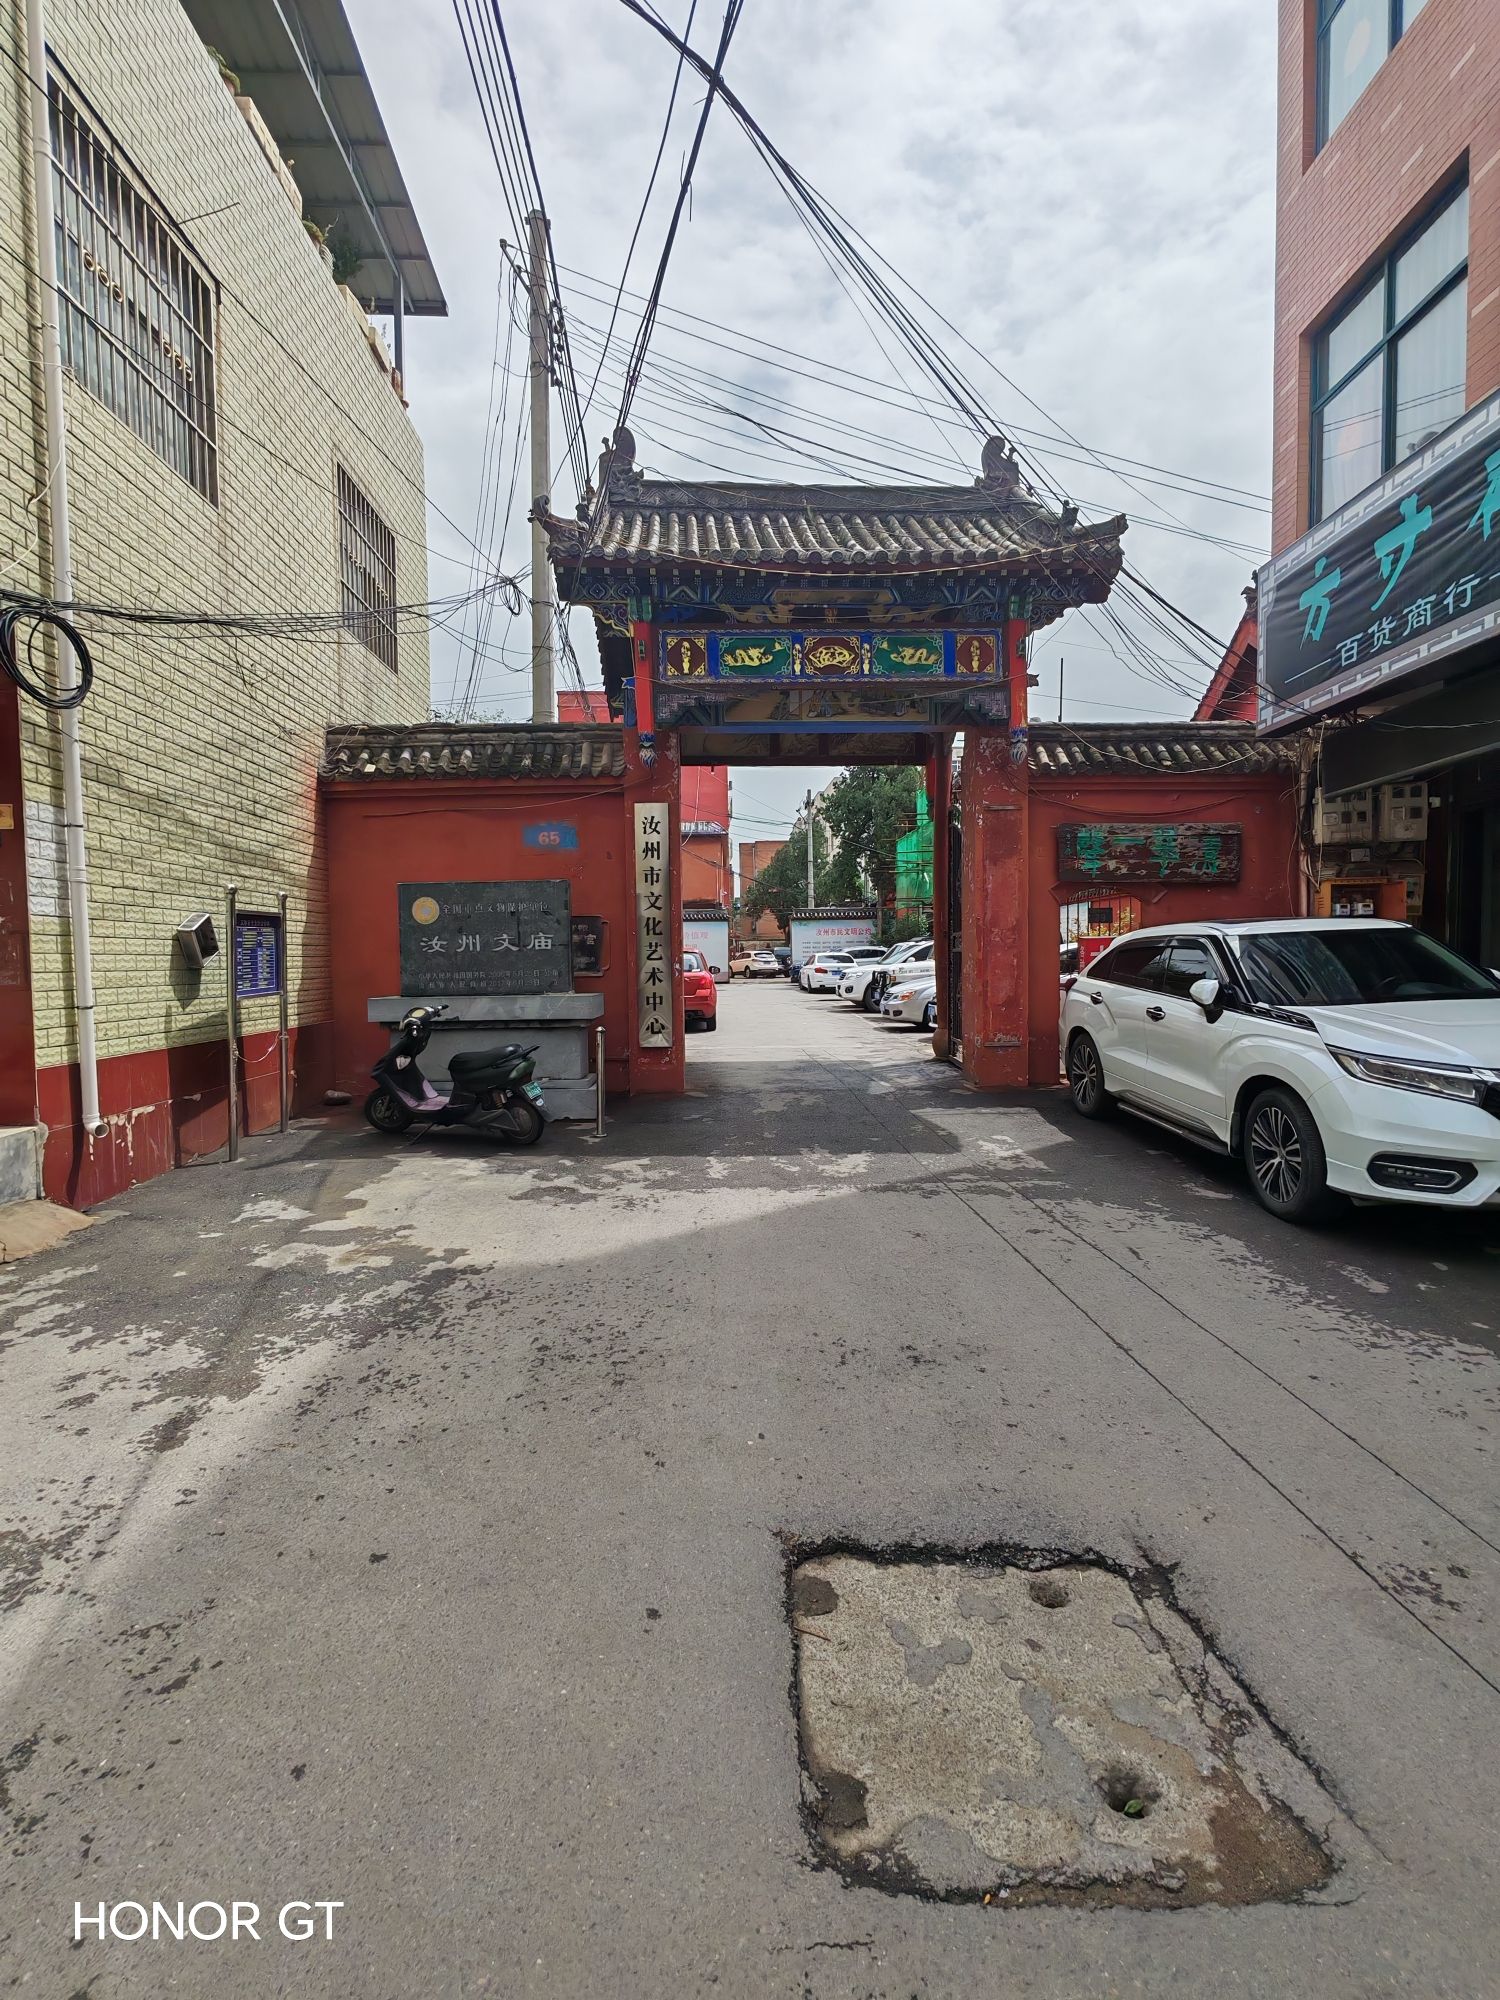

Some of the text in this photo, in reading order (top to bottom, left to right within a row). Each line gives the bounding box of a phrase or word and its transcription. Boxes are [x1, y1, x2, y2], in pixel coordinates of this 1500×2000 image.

[1335, 573, 1481, 668] 百货商行
[538, 831, 561, 846] 65
[420, 932, 554, 953] 汝州文庙
[640, 815, 666, 1036] 汝州市文化艺术中心
